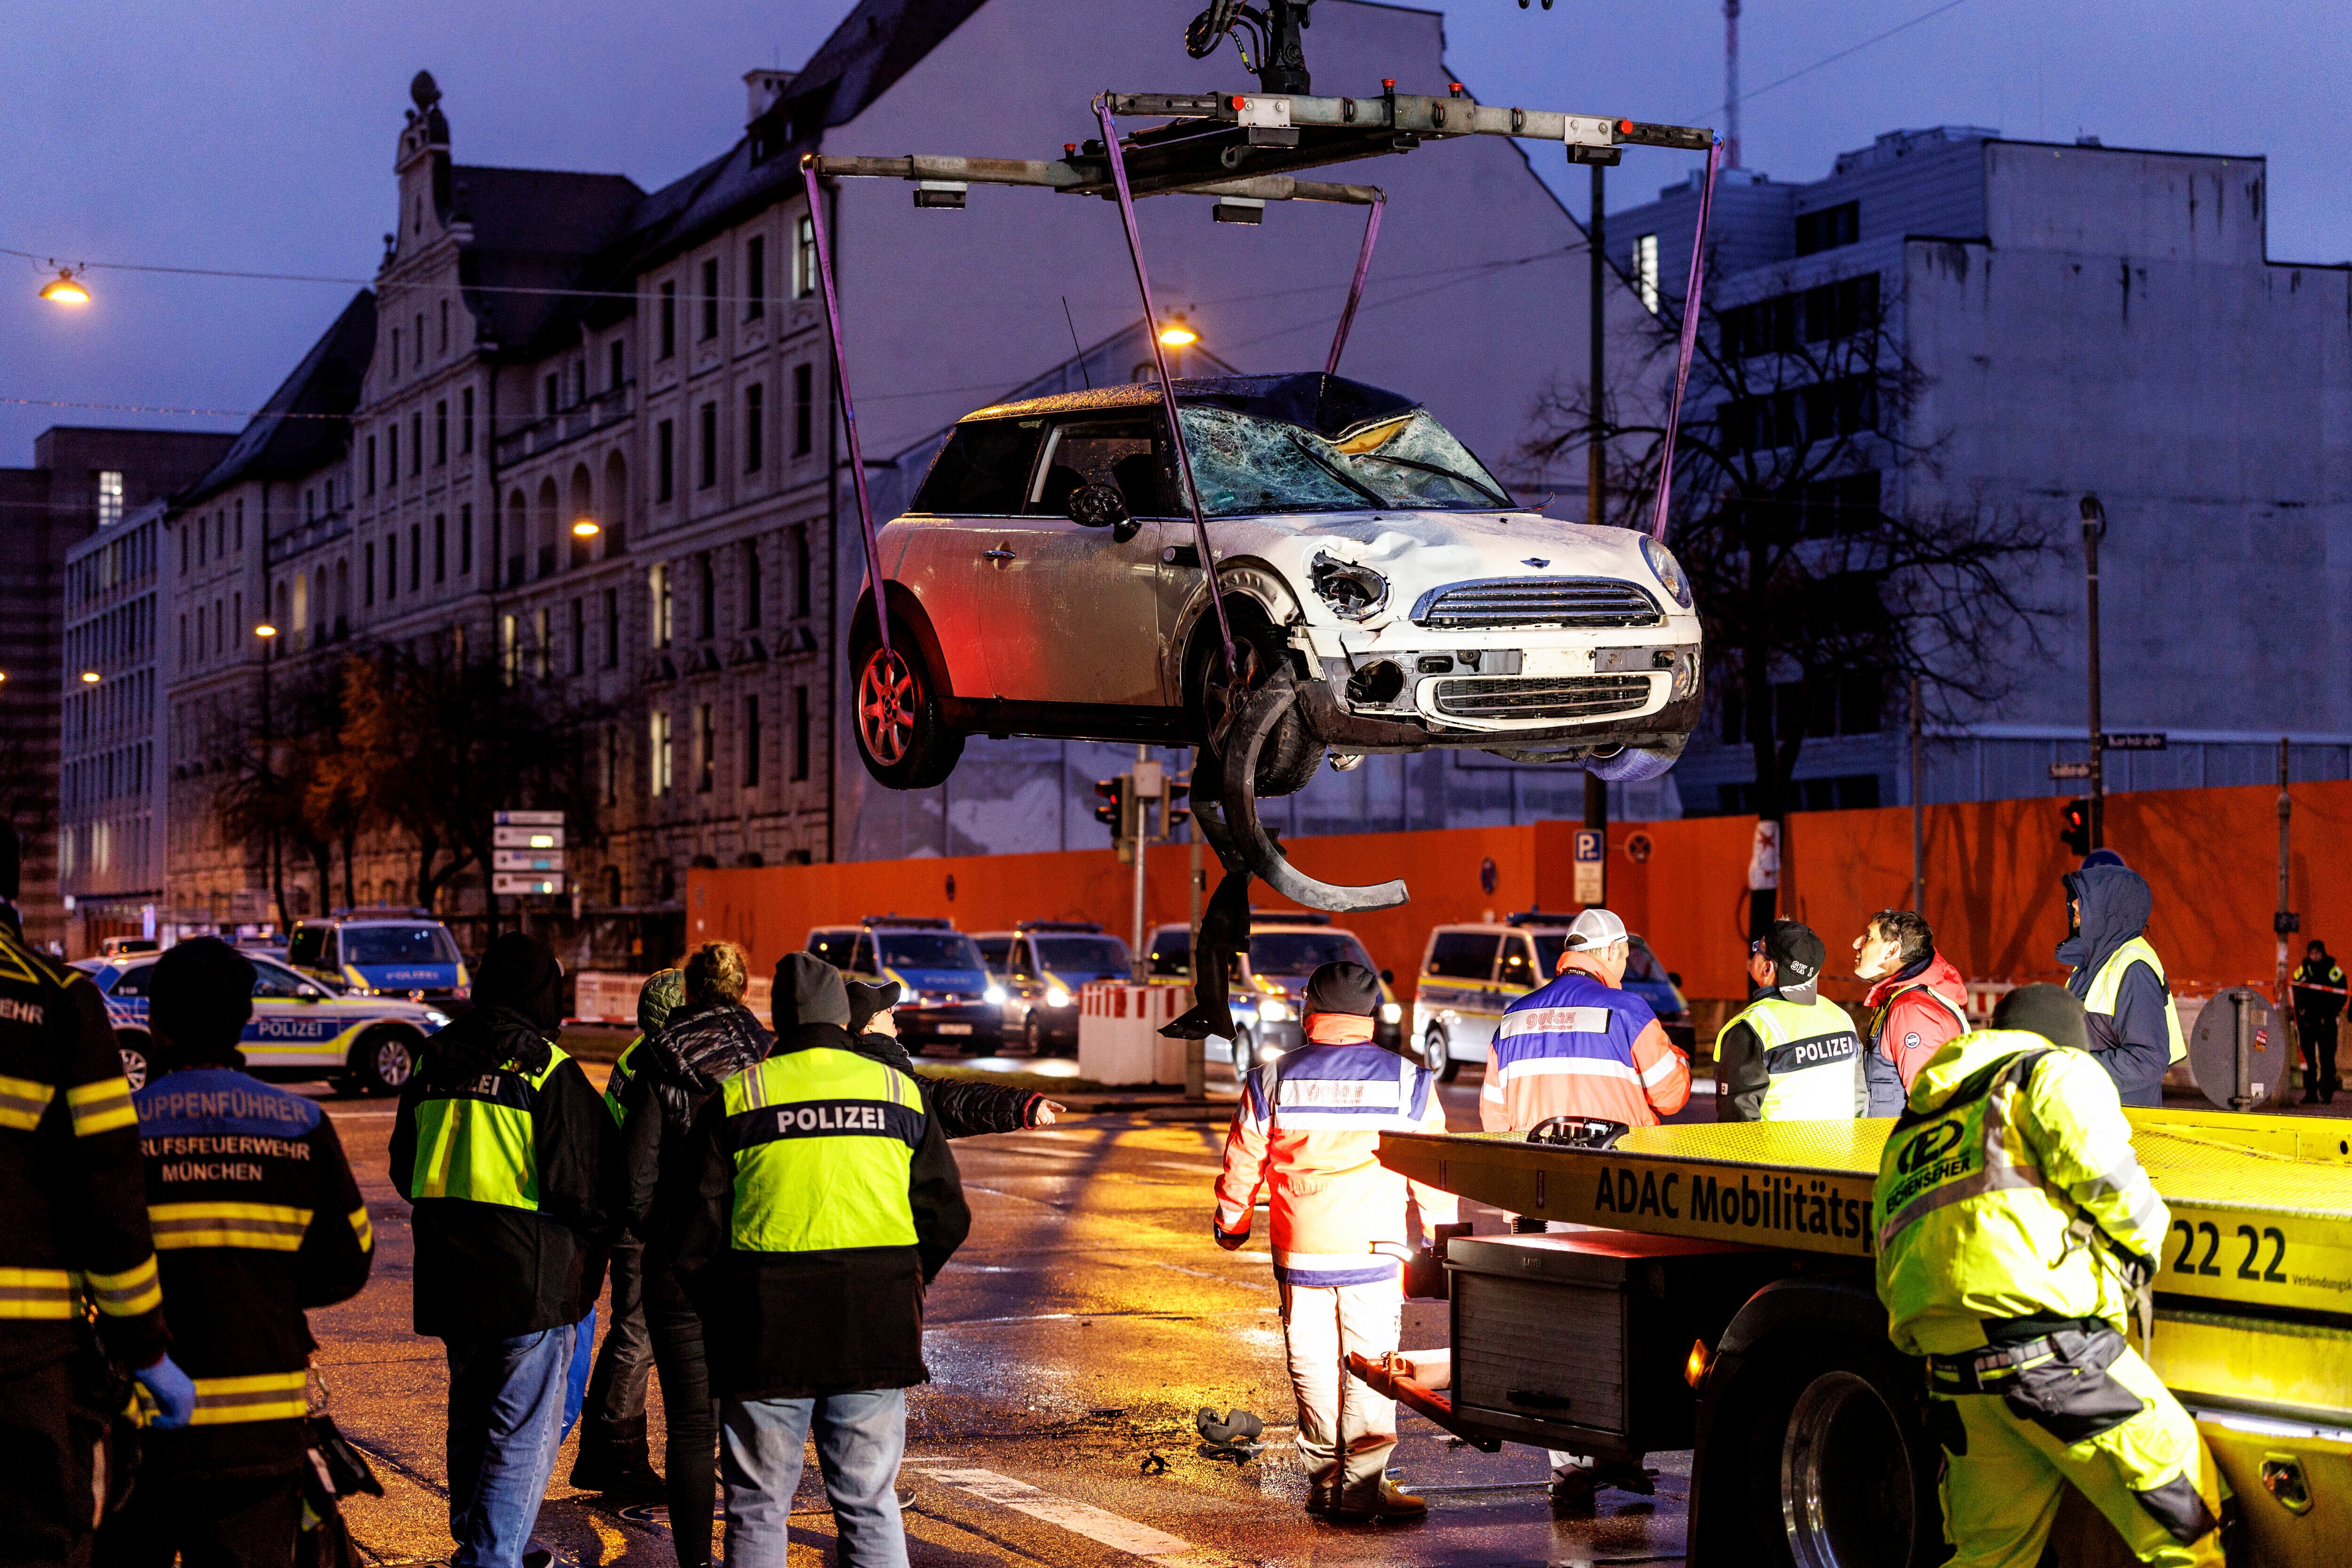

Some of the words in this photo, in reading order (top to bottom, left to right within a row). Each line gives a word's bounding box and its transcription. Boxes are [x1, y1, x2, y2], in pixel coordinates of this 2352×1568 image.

[1790, 960, 1808, 975] SK
[1807, 967, 1814, 977] 1
[259, 1021, 323, 1036] POLIZEI
[1526, 1009, 1576, 1030] gutax
[1795, 1036, 1853, 1064] POLIZEI
[777, 1106, 886, 1133] POLIZEI
[162, 1160, 263, 1182] MÜNCHEN
[1595, 1167, 1679, 1219] ADAC
[2174, 1219, 2221, 1277] 22
[2237, 1224, 2287, 1284] 22
